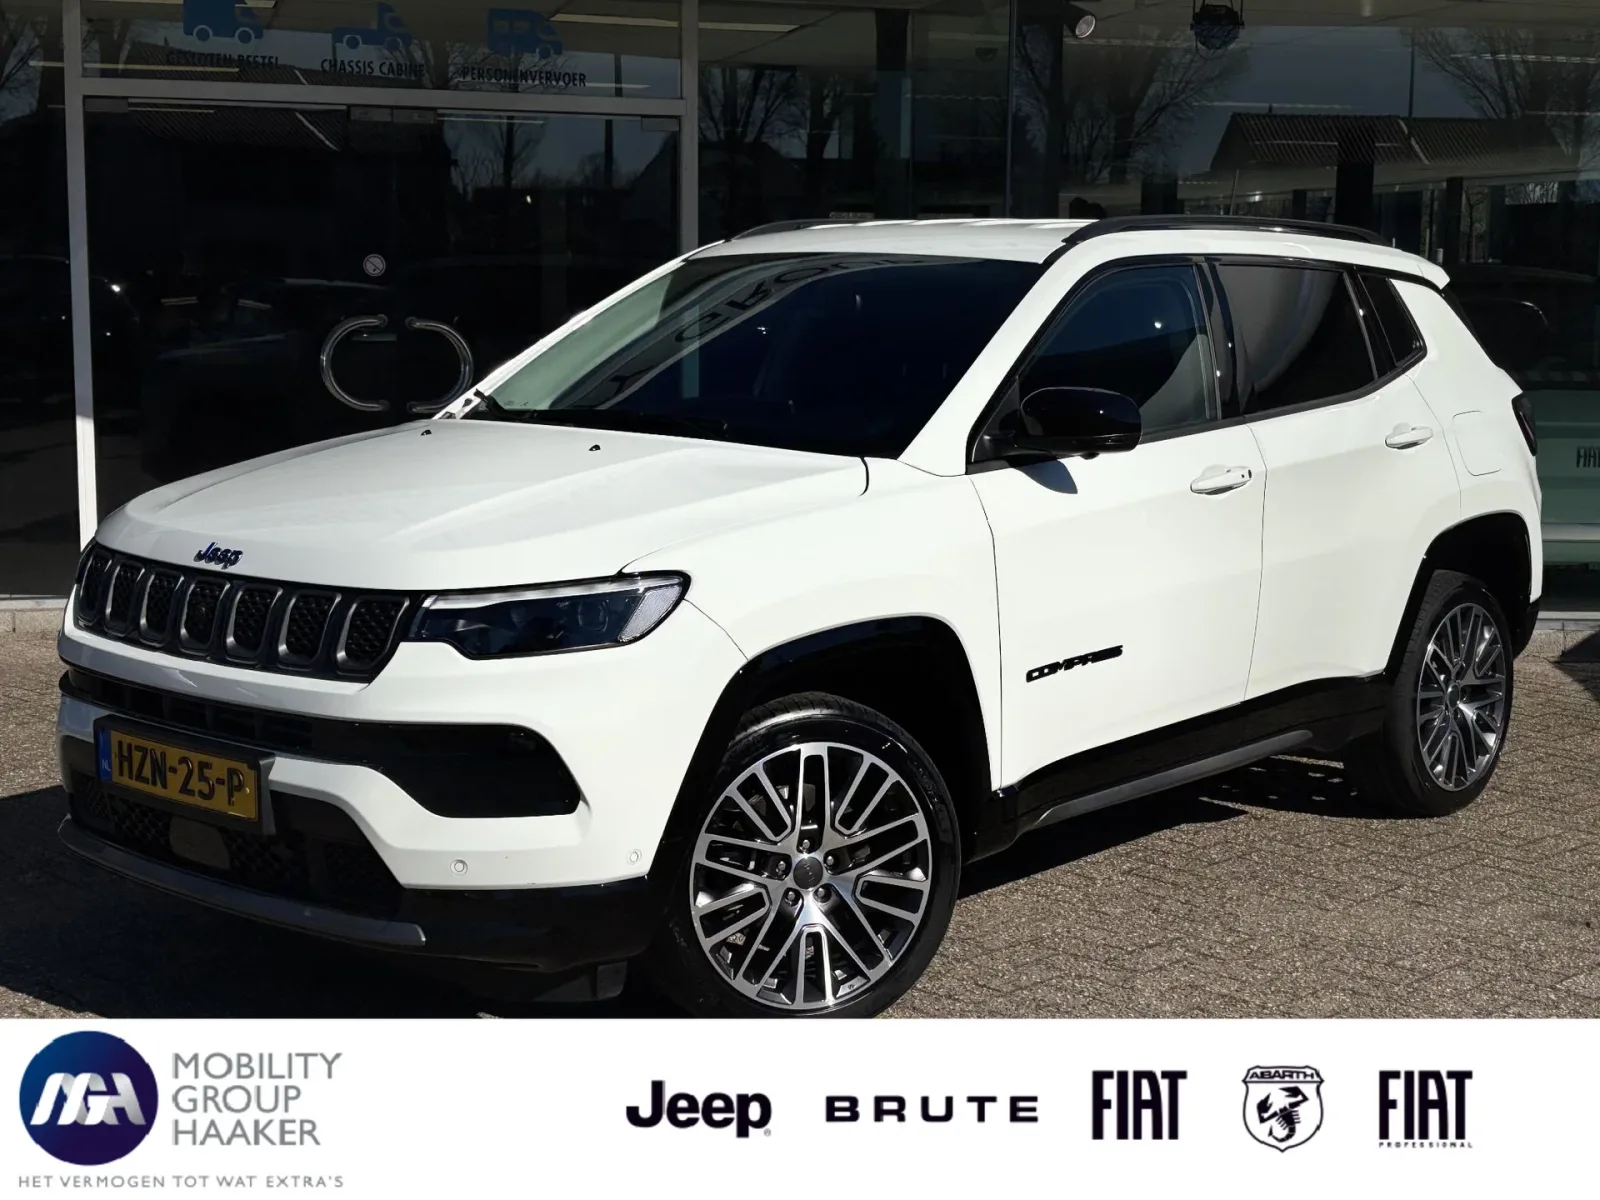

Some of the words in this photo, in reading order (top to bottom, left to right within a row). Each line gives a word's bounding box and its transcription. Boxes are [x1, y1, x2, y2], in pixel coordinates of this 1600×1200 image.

[321, 58, 374, 76] CHASSIS
[378, 61, 426, 79] CABINE
[461, 65, 587, 87] PERSONENVERVOER
[193, 541, 243, 570] Jeep
[101, 758, 112, 773] NL
[117, 740, 245, 806] HZN-25-P
